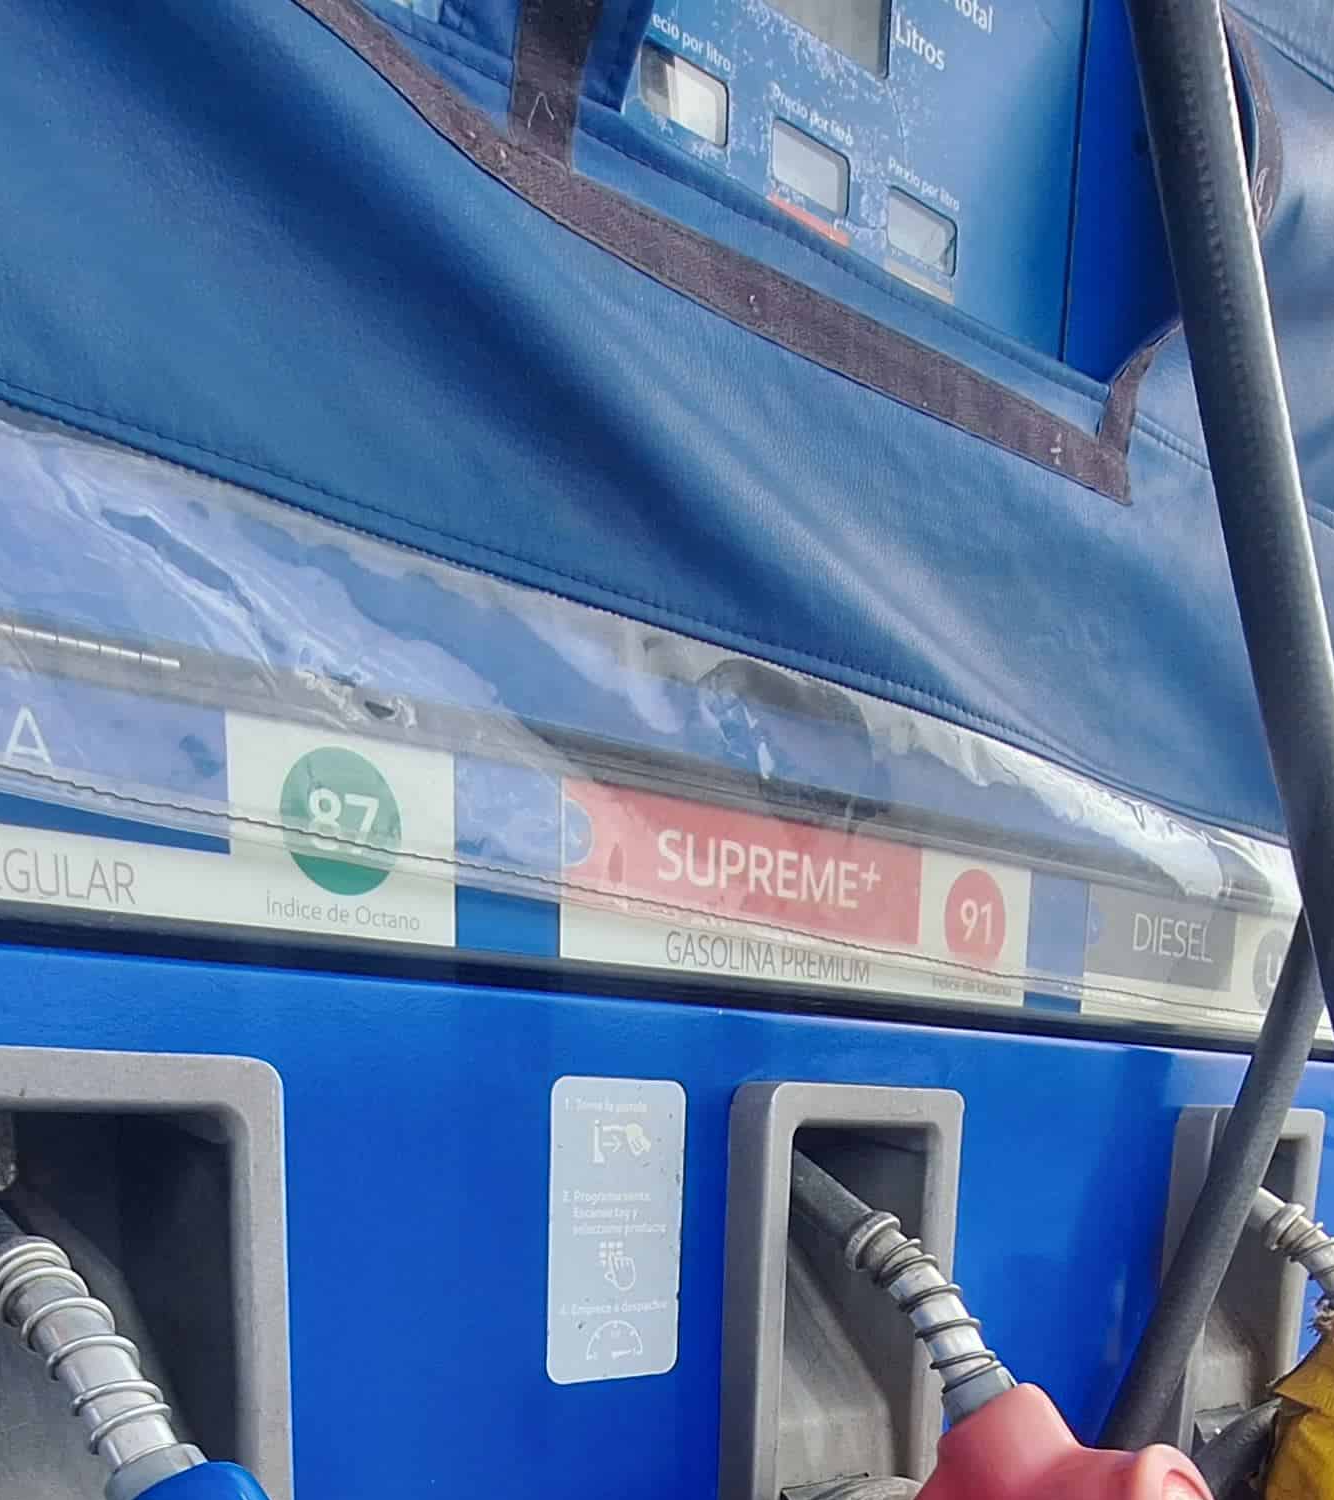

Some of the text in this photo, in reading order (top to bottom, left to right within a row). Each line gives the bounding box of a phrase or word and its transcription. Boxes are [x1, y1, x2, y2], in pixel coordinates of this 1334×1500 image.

[652, 13, 731, 72] ecio por litro
[895, 10, 945, 71] Litros
[308, 788, 379, 855] 87
[327, 903, 349, 923] de
[355, 904, 420, 931] Octano
[960, 898, 993, 945] 91
[1132, 911, 1213, 964] DIESEL
[666, 930, 872, 984] GASOLINA PREMIUM
